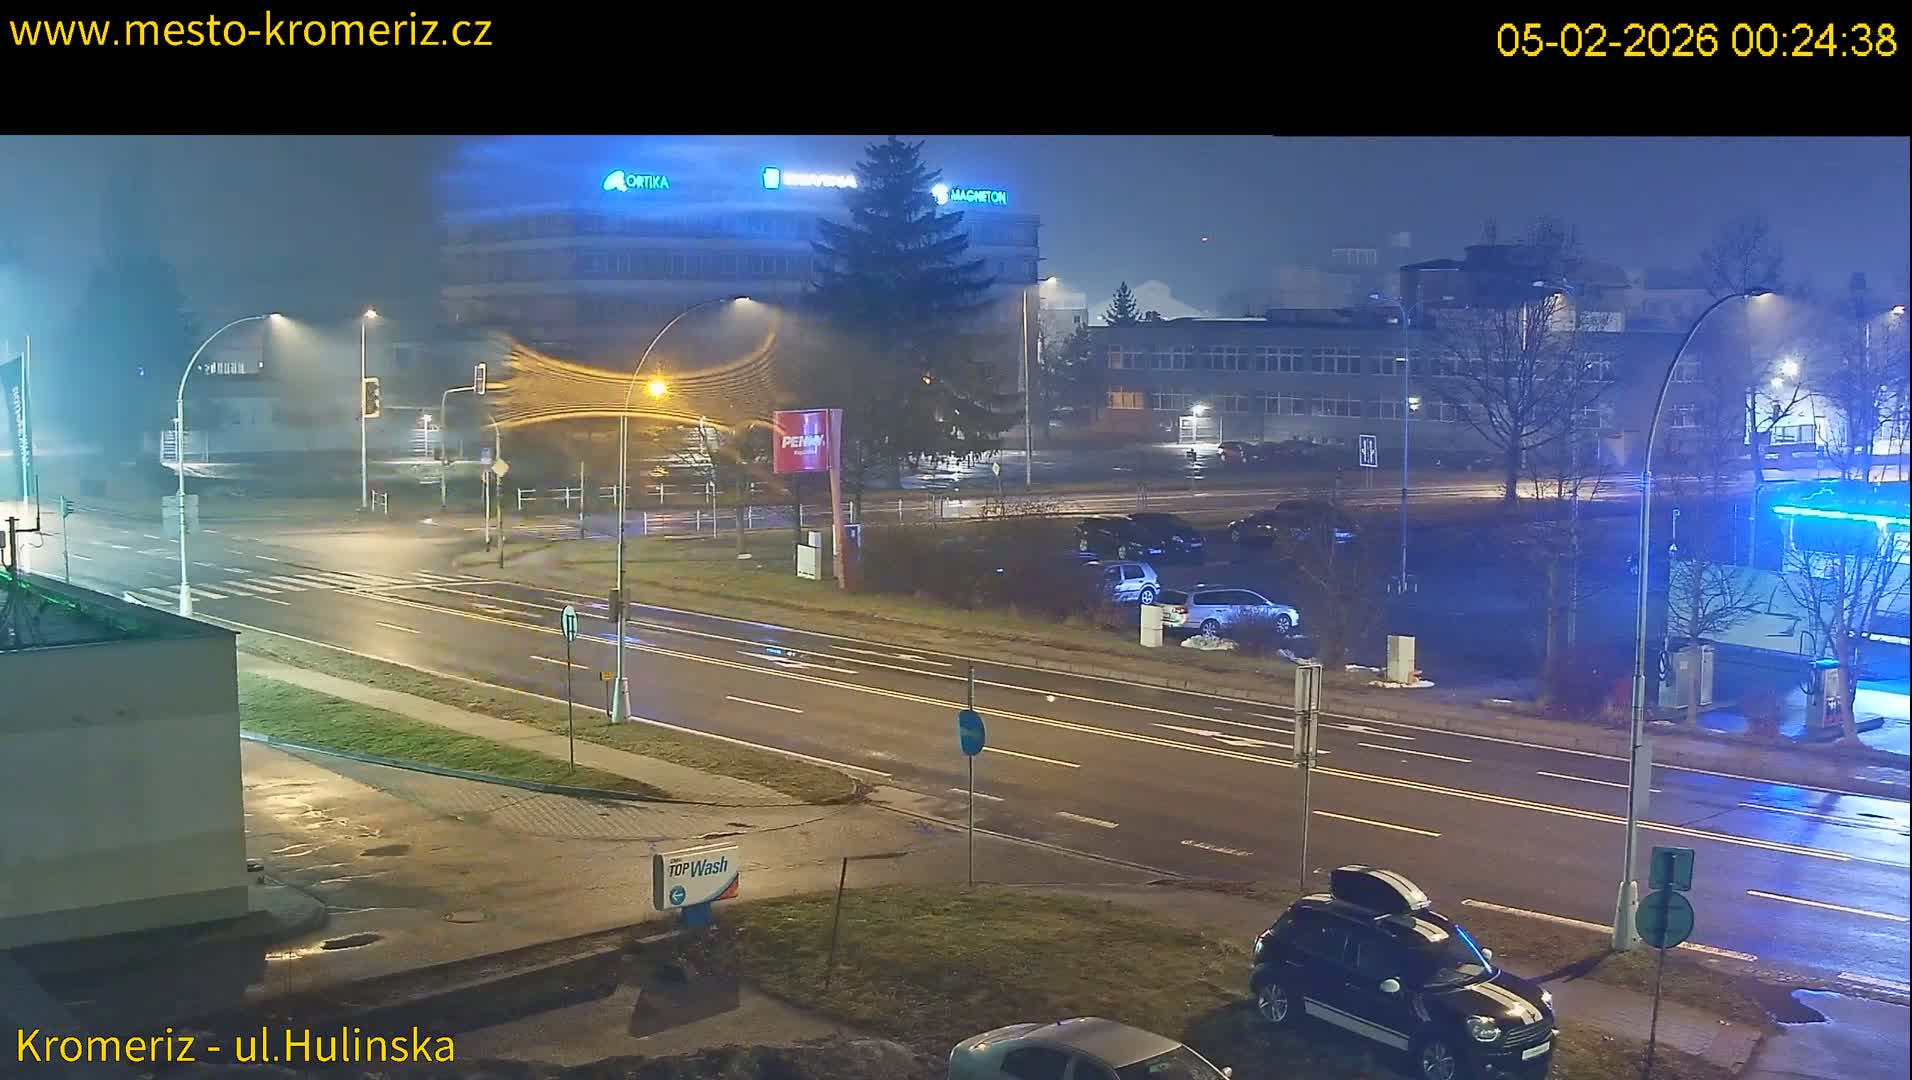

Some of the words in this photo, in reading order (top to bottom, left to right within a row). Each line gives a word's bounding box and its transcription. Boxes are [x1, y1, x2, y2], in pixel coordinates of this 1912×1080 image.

[626, 174, 670, 189] ORTIKA
[950, 188, 1008, 204] MAGNETON
[669, 862, 690, 877] TOP
[691, 856, 728, 877] Wash
